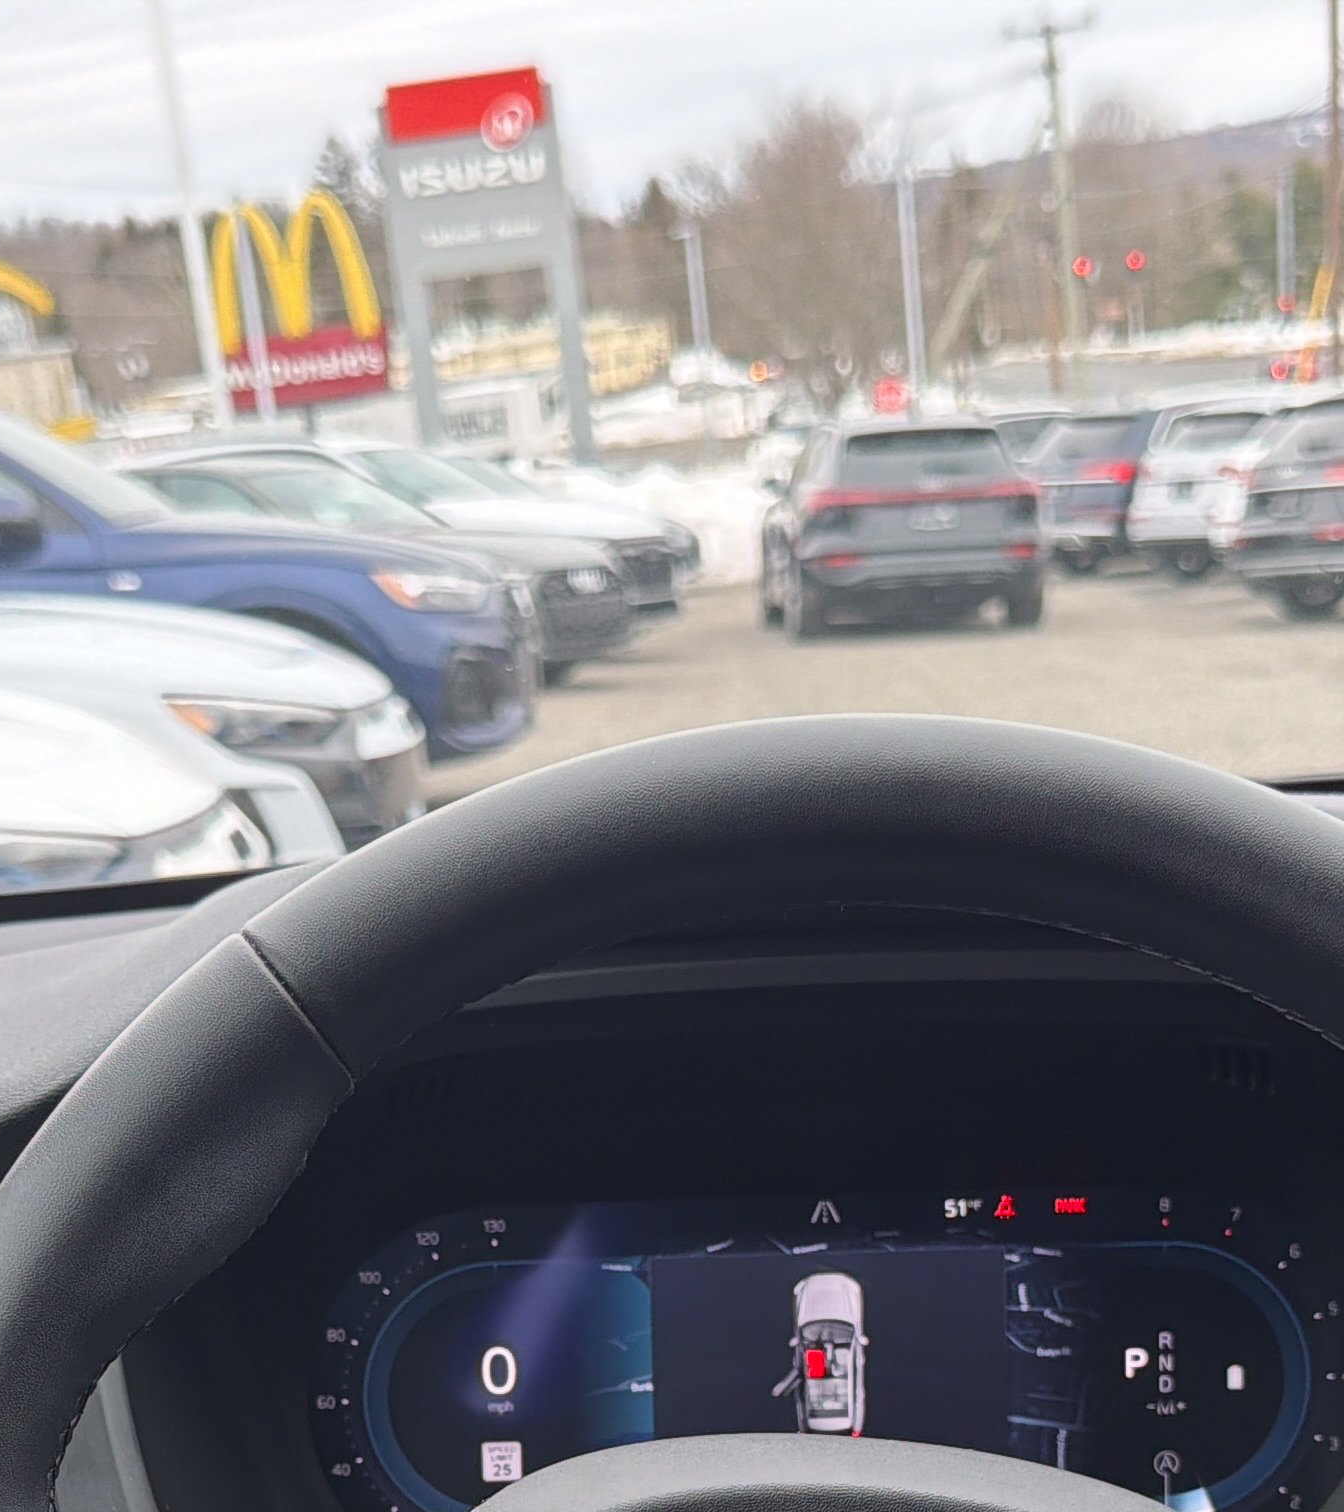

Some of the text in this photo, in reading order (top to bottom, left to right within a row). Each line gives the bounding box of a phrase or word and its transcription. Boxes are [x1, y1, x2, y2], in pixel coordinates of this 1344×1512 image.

[483, 1218, 506, 1234] 130
[415, 1231, 440, 1246] 120
[358, 1270, 382, 1285] 100
[1158, 1331, 1175, 1350] R
[481, 1346, 517, 1396] 0
[1125, 1347, 1149, 1379] P
[1158, 1353, 1175, 1372] N
[1158, 1374, 1175, 1393] D
[331, 1463, 351, 1477] 40
[493, 1463, 513, 1477] 25
